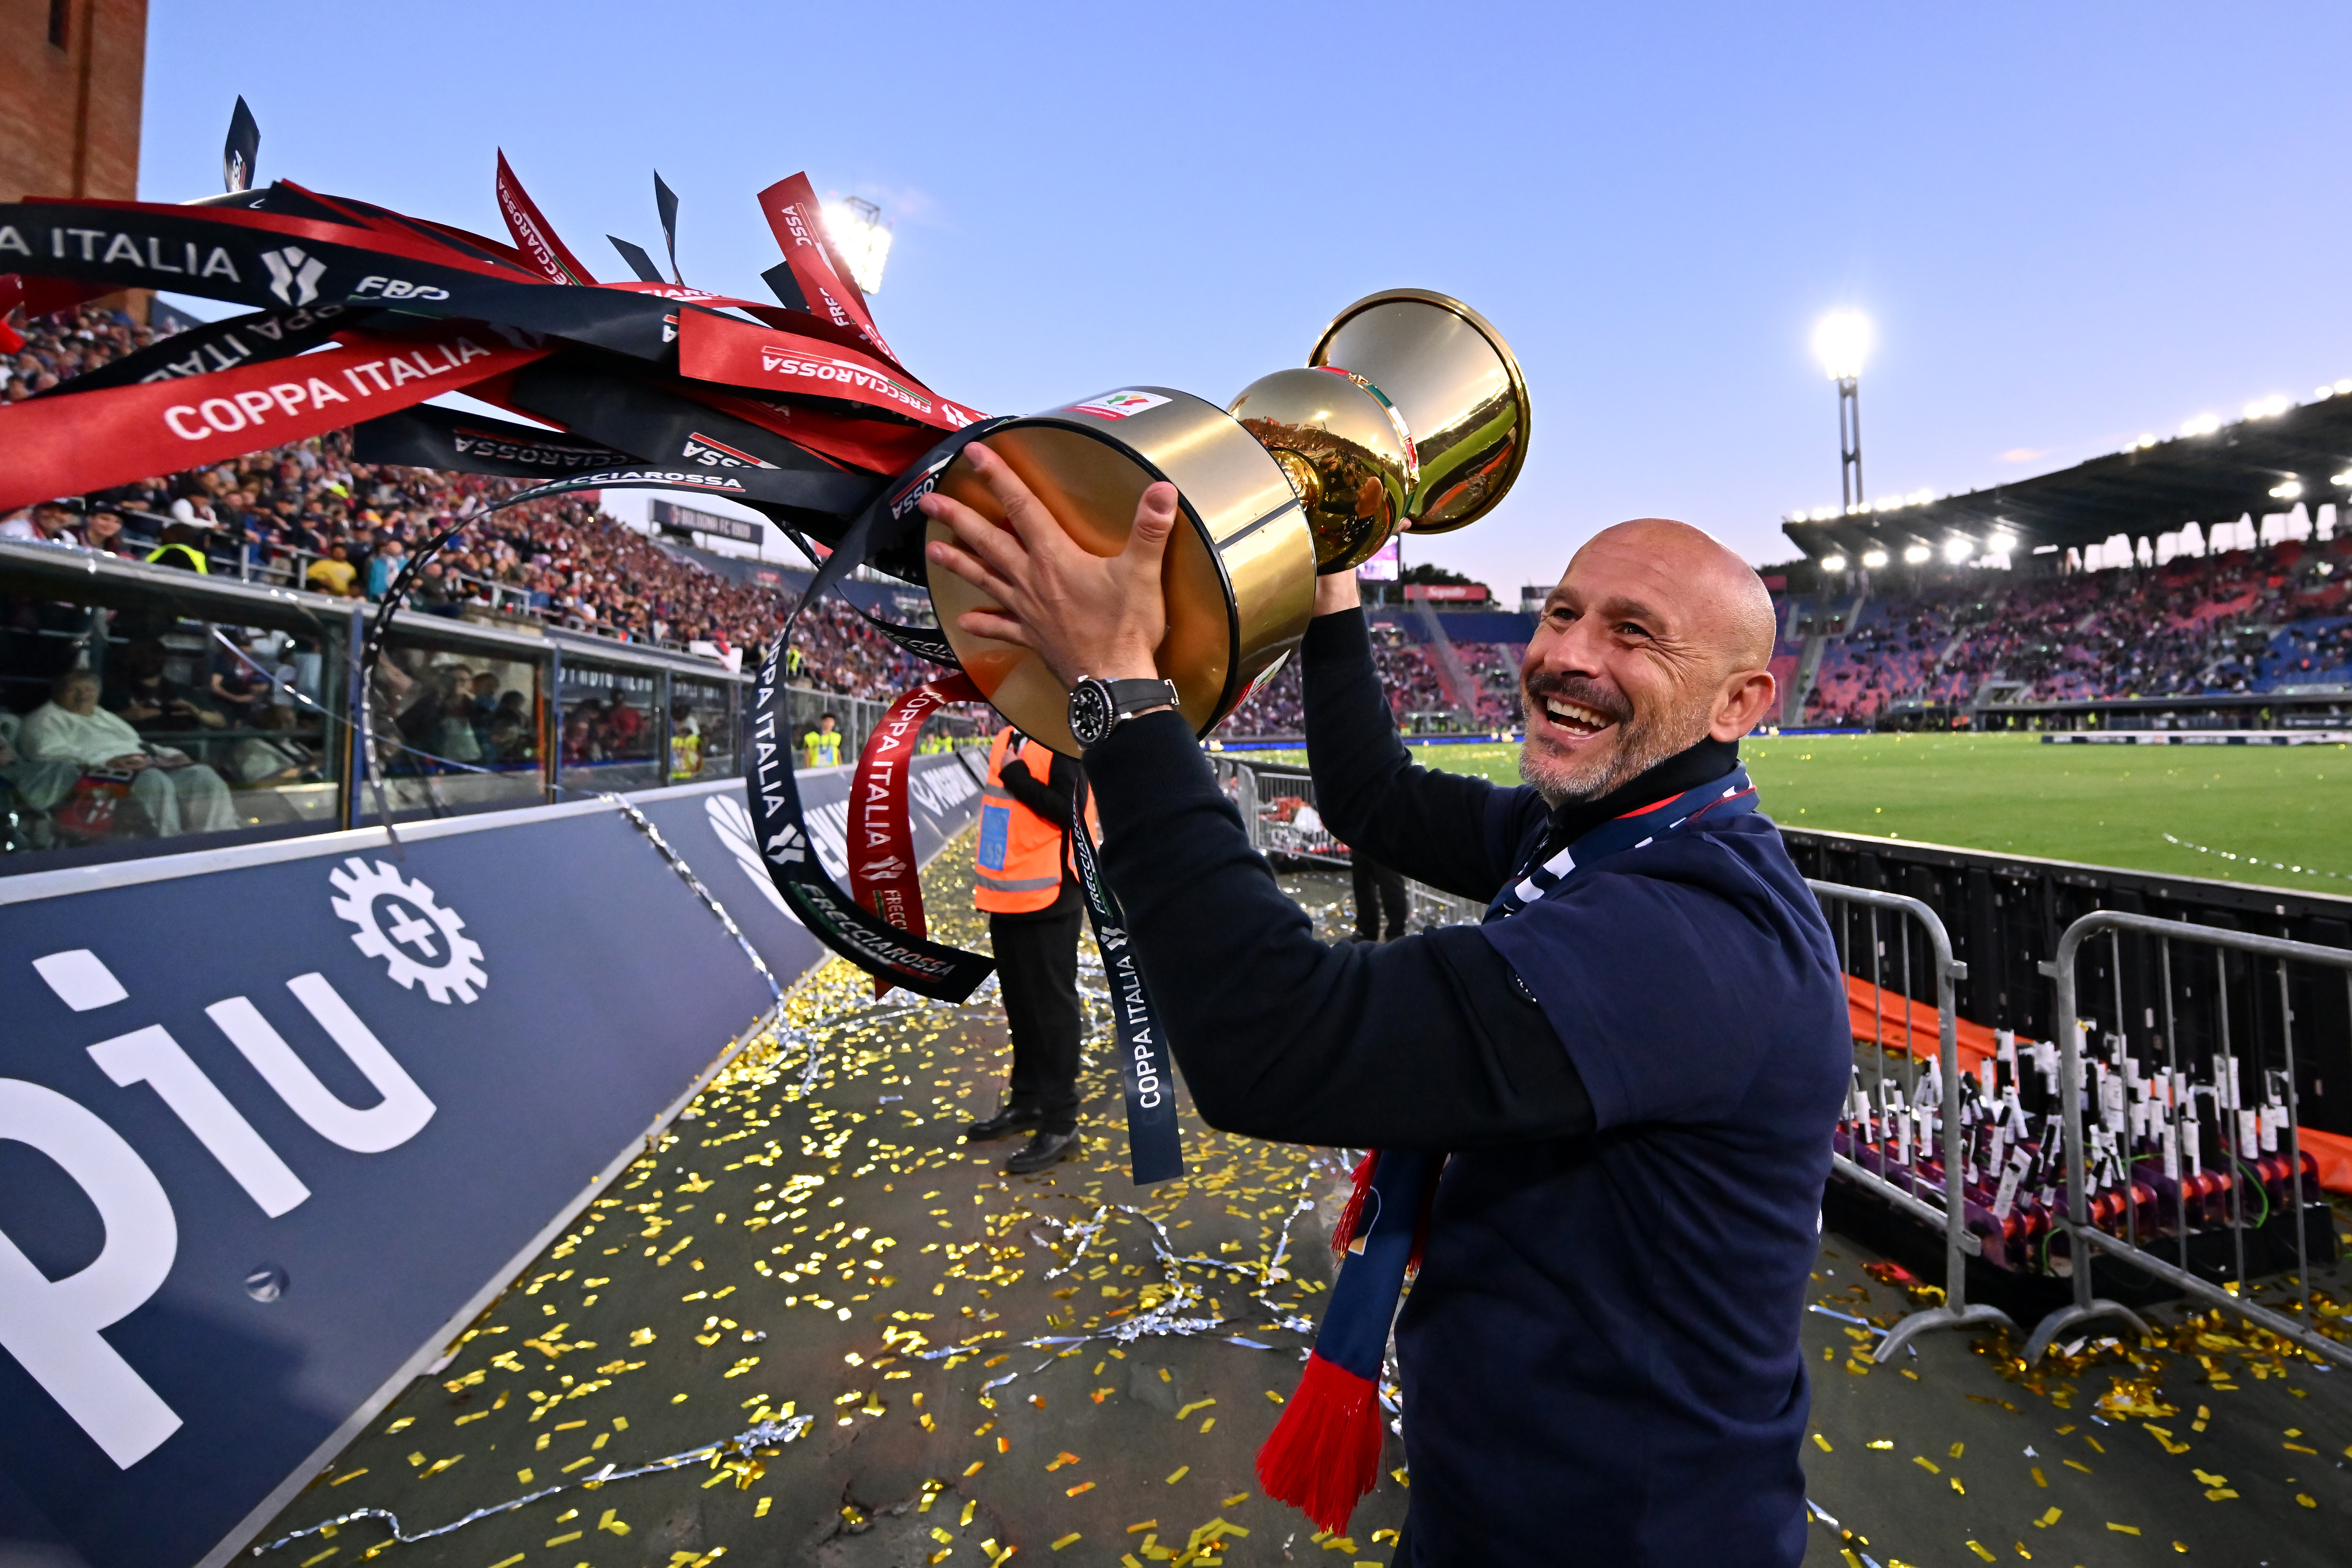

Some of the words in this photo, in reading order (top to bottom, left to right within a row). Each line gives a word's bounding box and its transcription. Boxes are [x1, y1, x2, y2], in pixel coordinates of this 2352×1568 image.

[51, 227, 241, 283] ITALIA
[498, 178, 572, 286] ECCIAROSSA
[163, 377, 351, 441] COPPA
[342, 336, 492, 397] ITALIA
[762, 354, 932, 415] FRECCIAROSSA
[454, 436, 630, 467] CCIAROSSA
[876, 691, 942, 753] COPPA
[755, 710, 785, 819] ITALIA
[865, 761, 894, 849] ITALIA
[800, 883, 957, 976] FRECCIAROSSA
[1116, 955, 1148, 1024] ITALIA
[1133, 1027, 1161, 1109] COPPA
